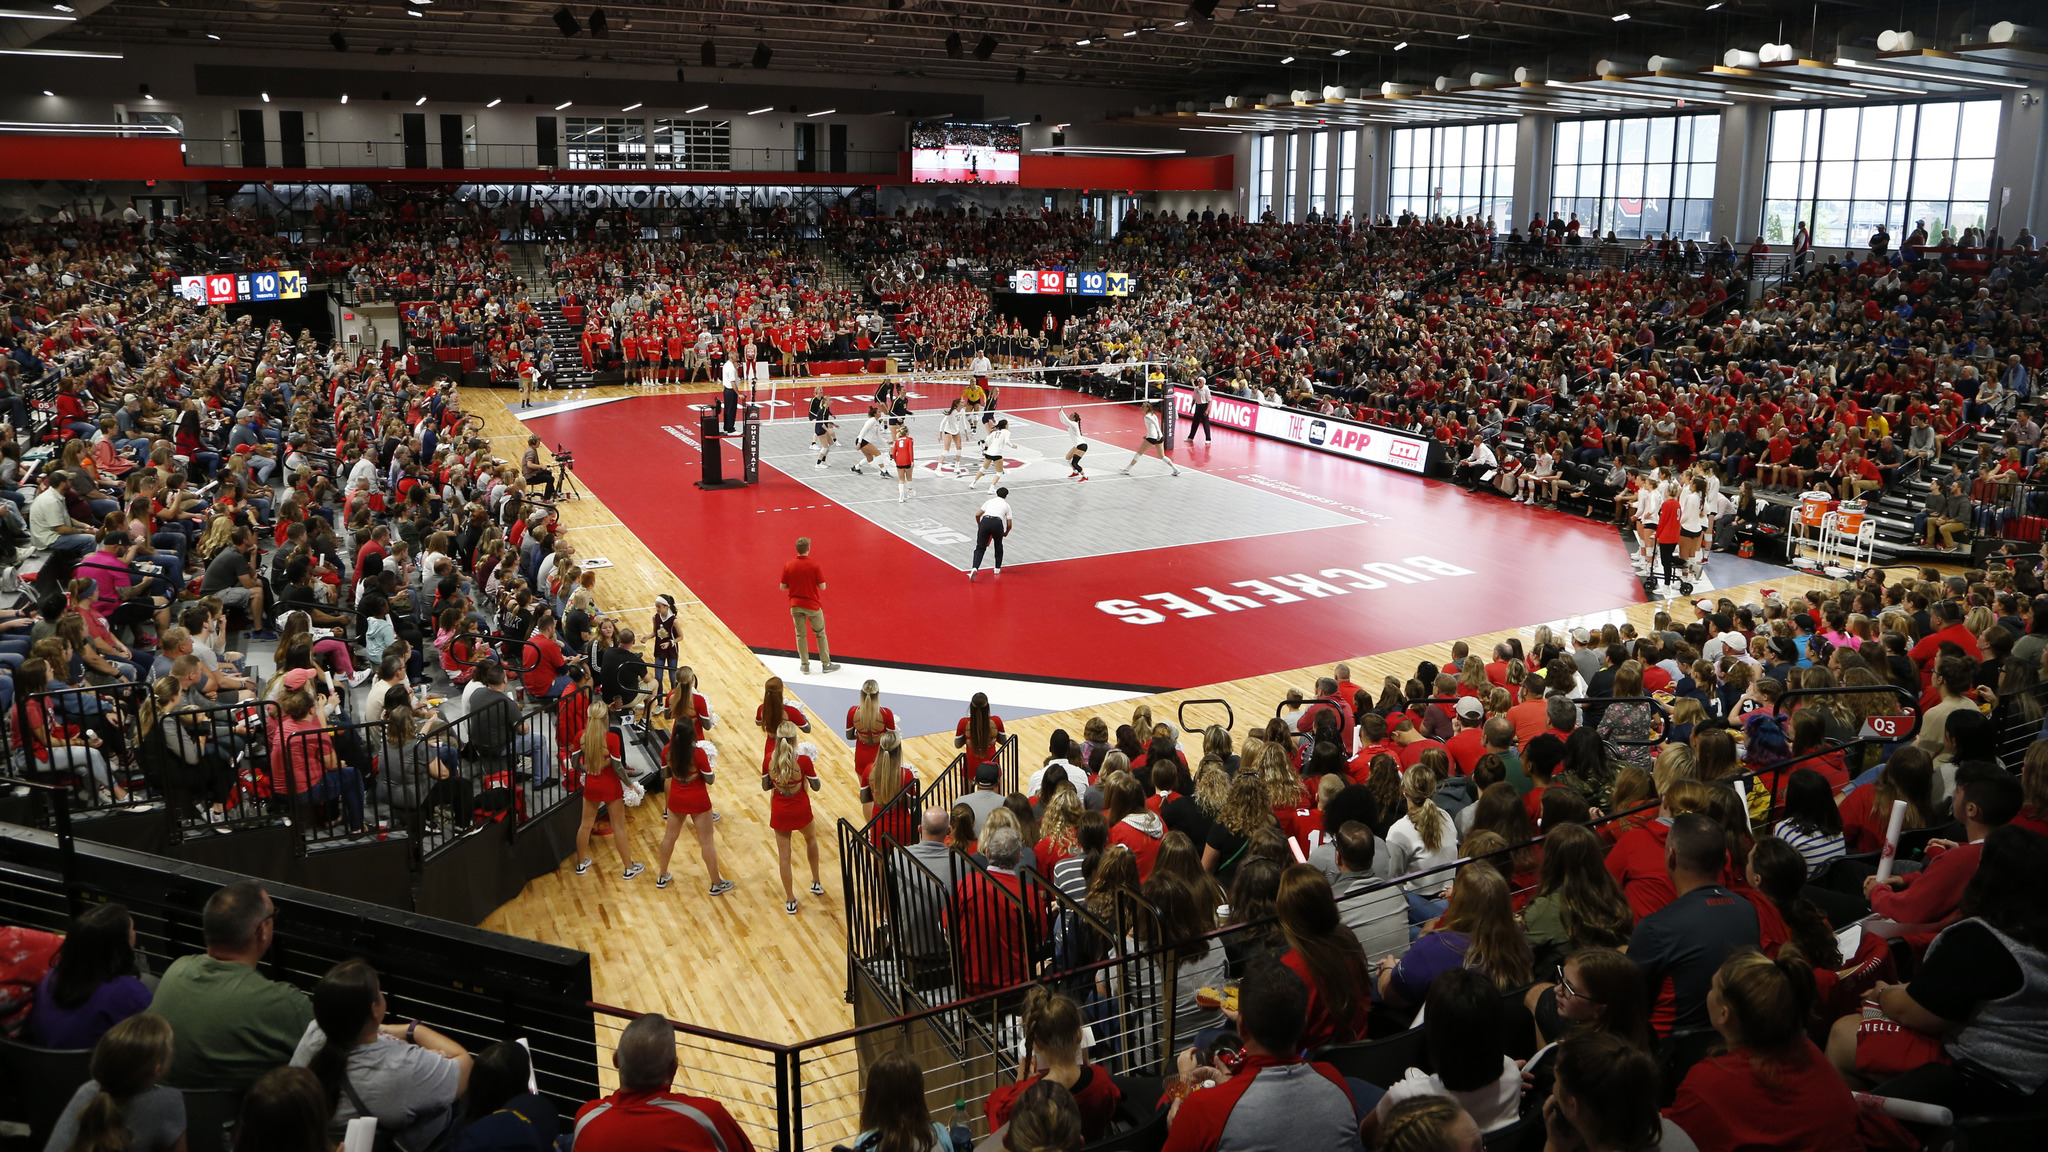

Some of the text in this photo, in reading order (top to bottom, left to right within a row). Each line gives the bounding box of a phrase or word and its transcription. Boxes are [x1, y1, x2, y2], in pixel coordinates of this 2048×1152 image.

[556, 185, 678, 208] HONOR
[679, 185, 794, 208] DEFEND
[210, 277, 231, 295] 10
[255, 275, 275, 292] 10
[279, 276, 299, 294] M
[1009, 281, 1016, 289] 0
[1041, 273, 1060, 286] 10
[1083, 274, 1102, 288] 10
[1106, 277, 1127, 292] M
[300, 284, 307, 293] 0
[1128, 285, 1135, 293] 0
[1288, 415, 1305, 440] THE
[1329, 428, 1371, 452] APP
[1390, 441, 1420, 460] BTN
[1094, 555, 1479, 625] BUCKEYES
[1873, 717, 1896, 735] 03
